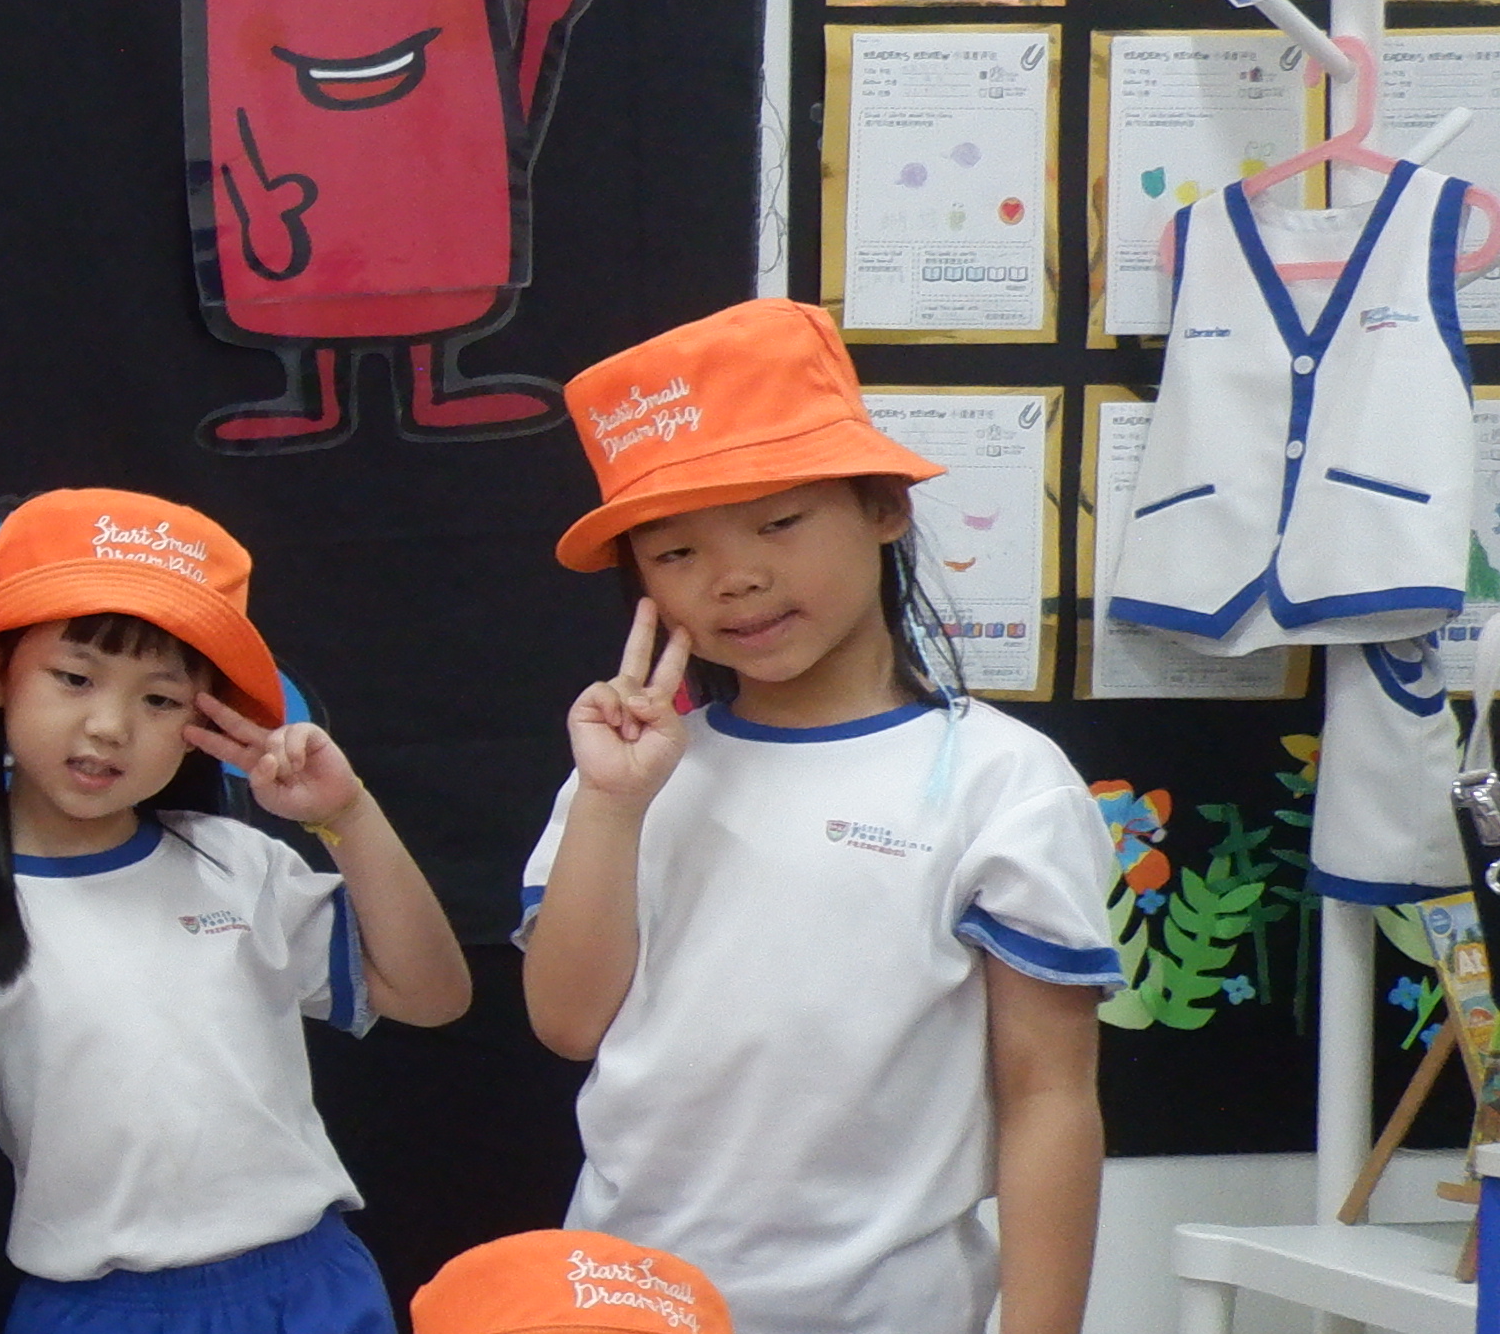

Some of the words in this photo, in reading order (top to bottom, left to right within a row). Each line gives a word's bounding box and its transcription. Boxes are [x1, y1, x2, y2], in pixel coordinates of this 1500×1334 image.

[567, 1250, 636, 1283] Start
[634, 1257, 694, 1305] Small
[574, 1283, 660, 1308] Dream
